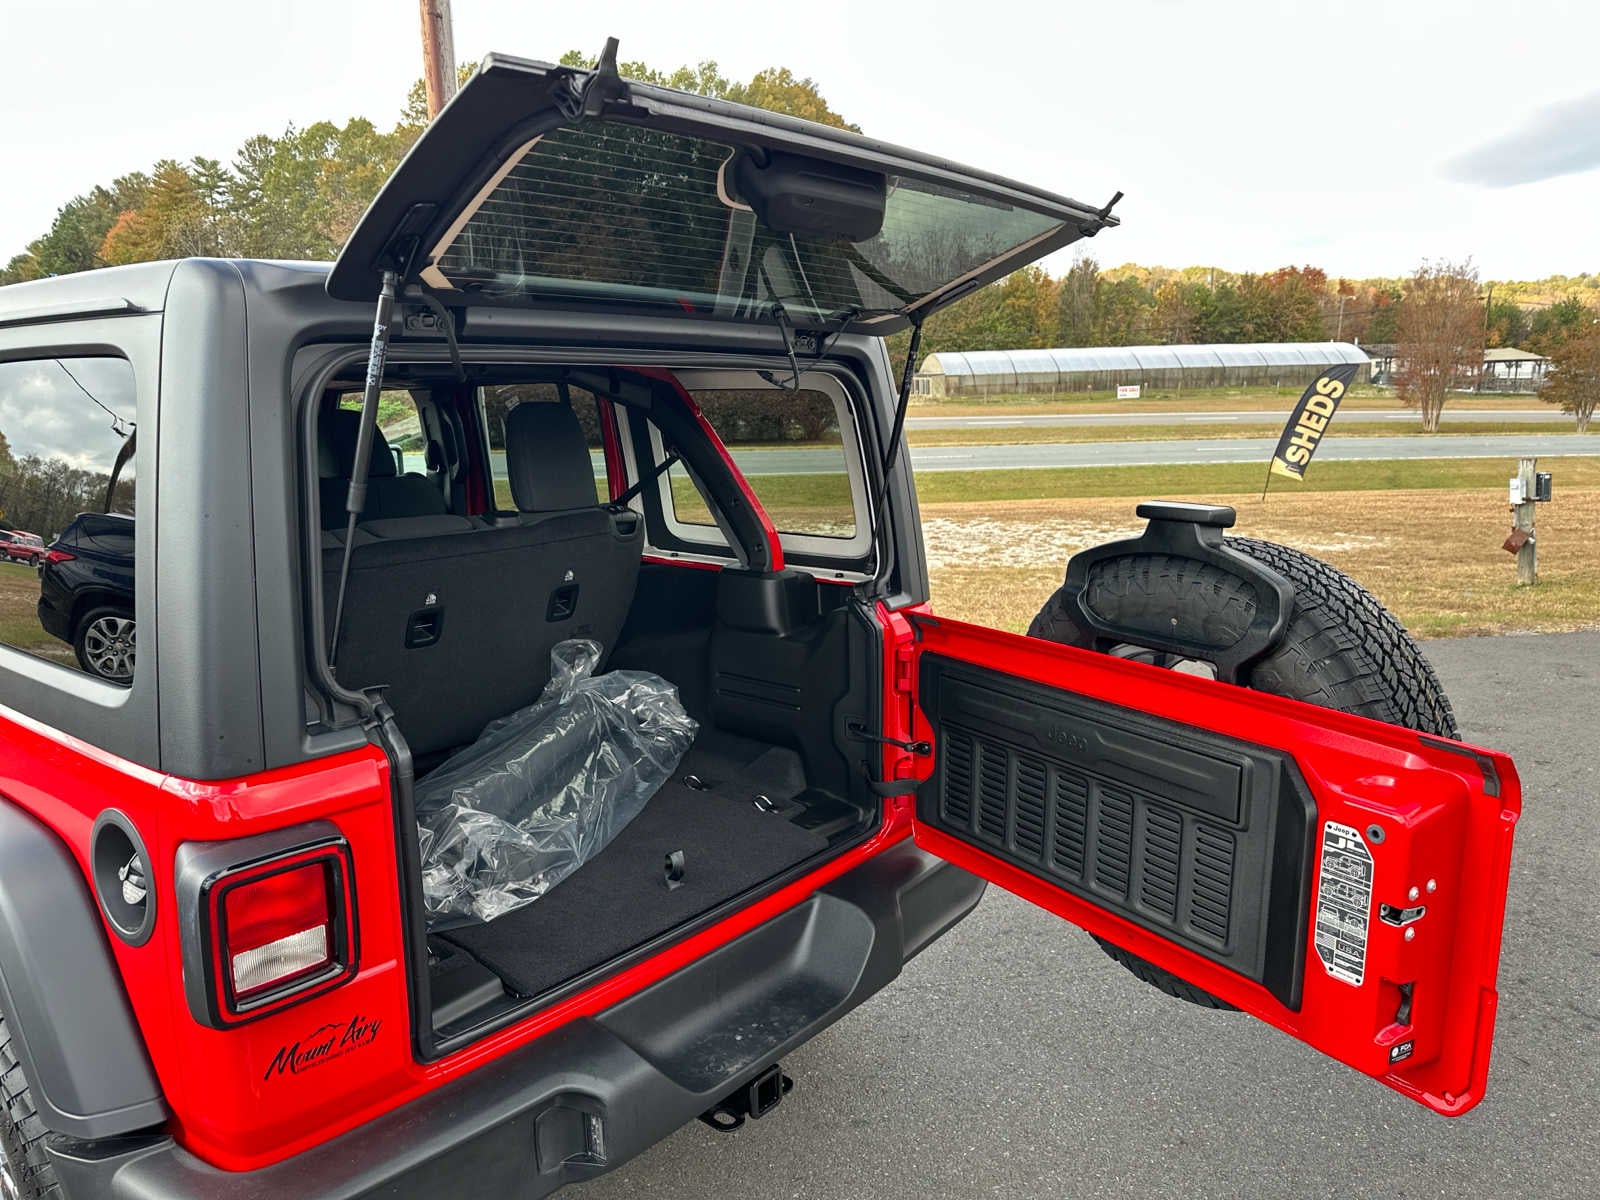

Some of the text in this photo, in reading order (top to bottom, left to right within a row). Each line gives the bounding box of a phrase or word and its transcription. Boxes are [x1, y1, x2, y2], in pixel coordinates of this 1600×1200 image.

[1285, 377, 1345, 466] SHEDS
[1048, 726, 1089, 753] Jeep
[1333, 825, 1350, 836] Jeep
[1325, 836, 1367, 855] JL
[1336, 942, 1362, 959] USA
[263, 1035, 337, 1081] Mount
[339, 1014, 383, 1047] Airy
